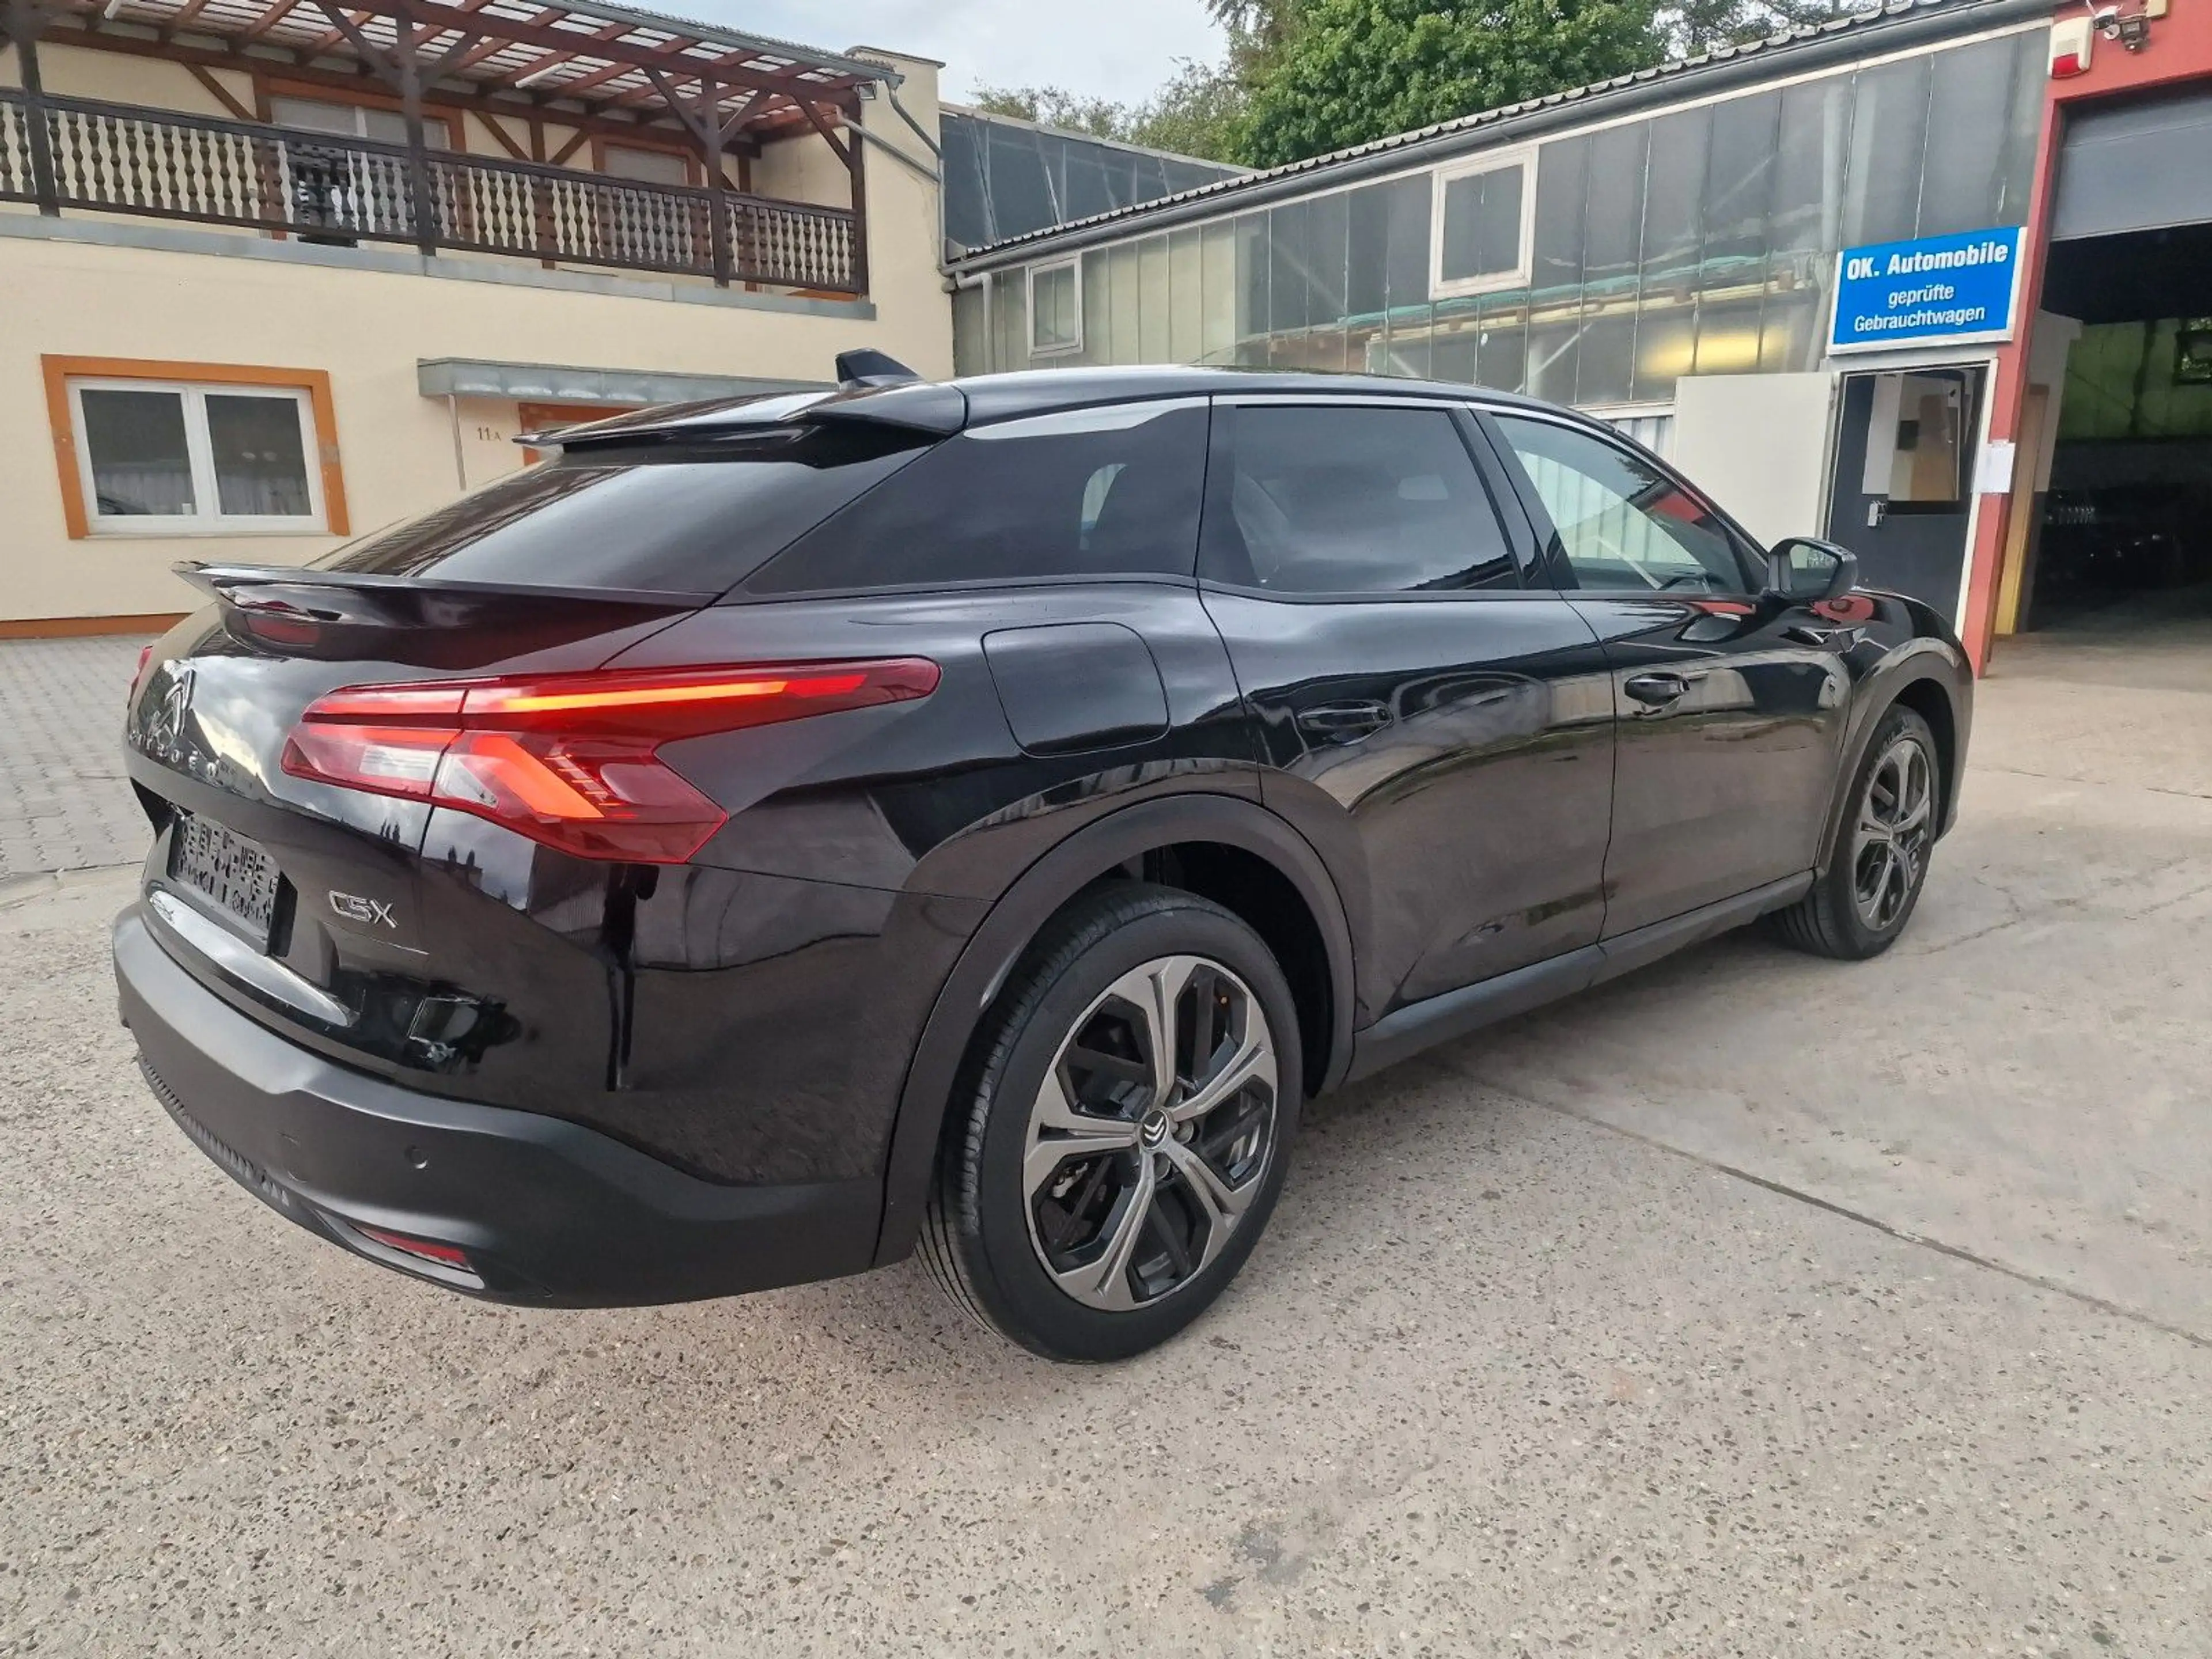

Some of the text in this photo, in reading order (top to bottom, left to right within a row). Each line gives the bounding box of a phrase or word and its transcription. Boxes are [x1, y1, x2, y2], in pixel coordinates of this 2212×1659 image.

[1847, 242, 2008, 280] OK. Automobile
[1888, 285, 1955, 308] geprüfte
[1854, 307, 1985, 332] Gebrauchtwagen
